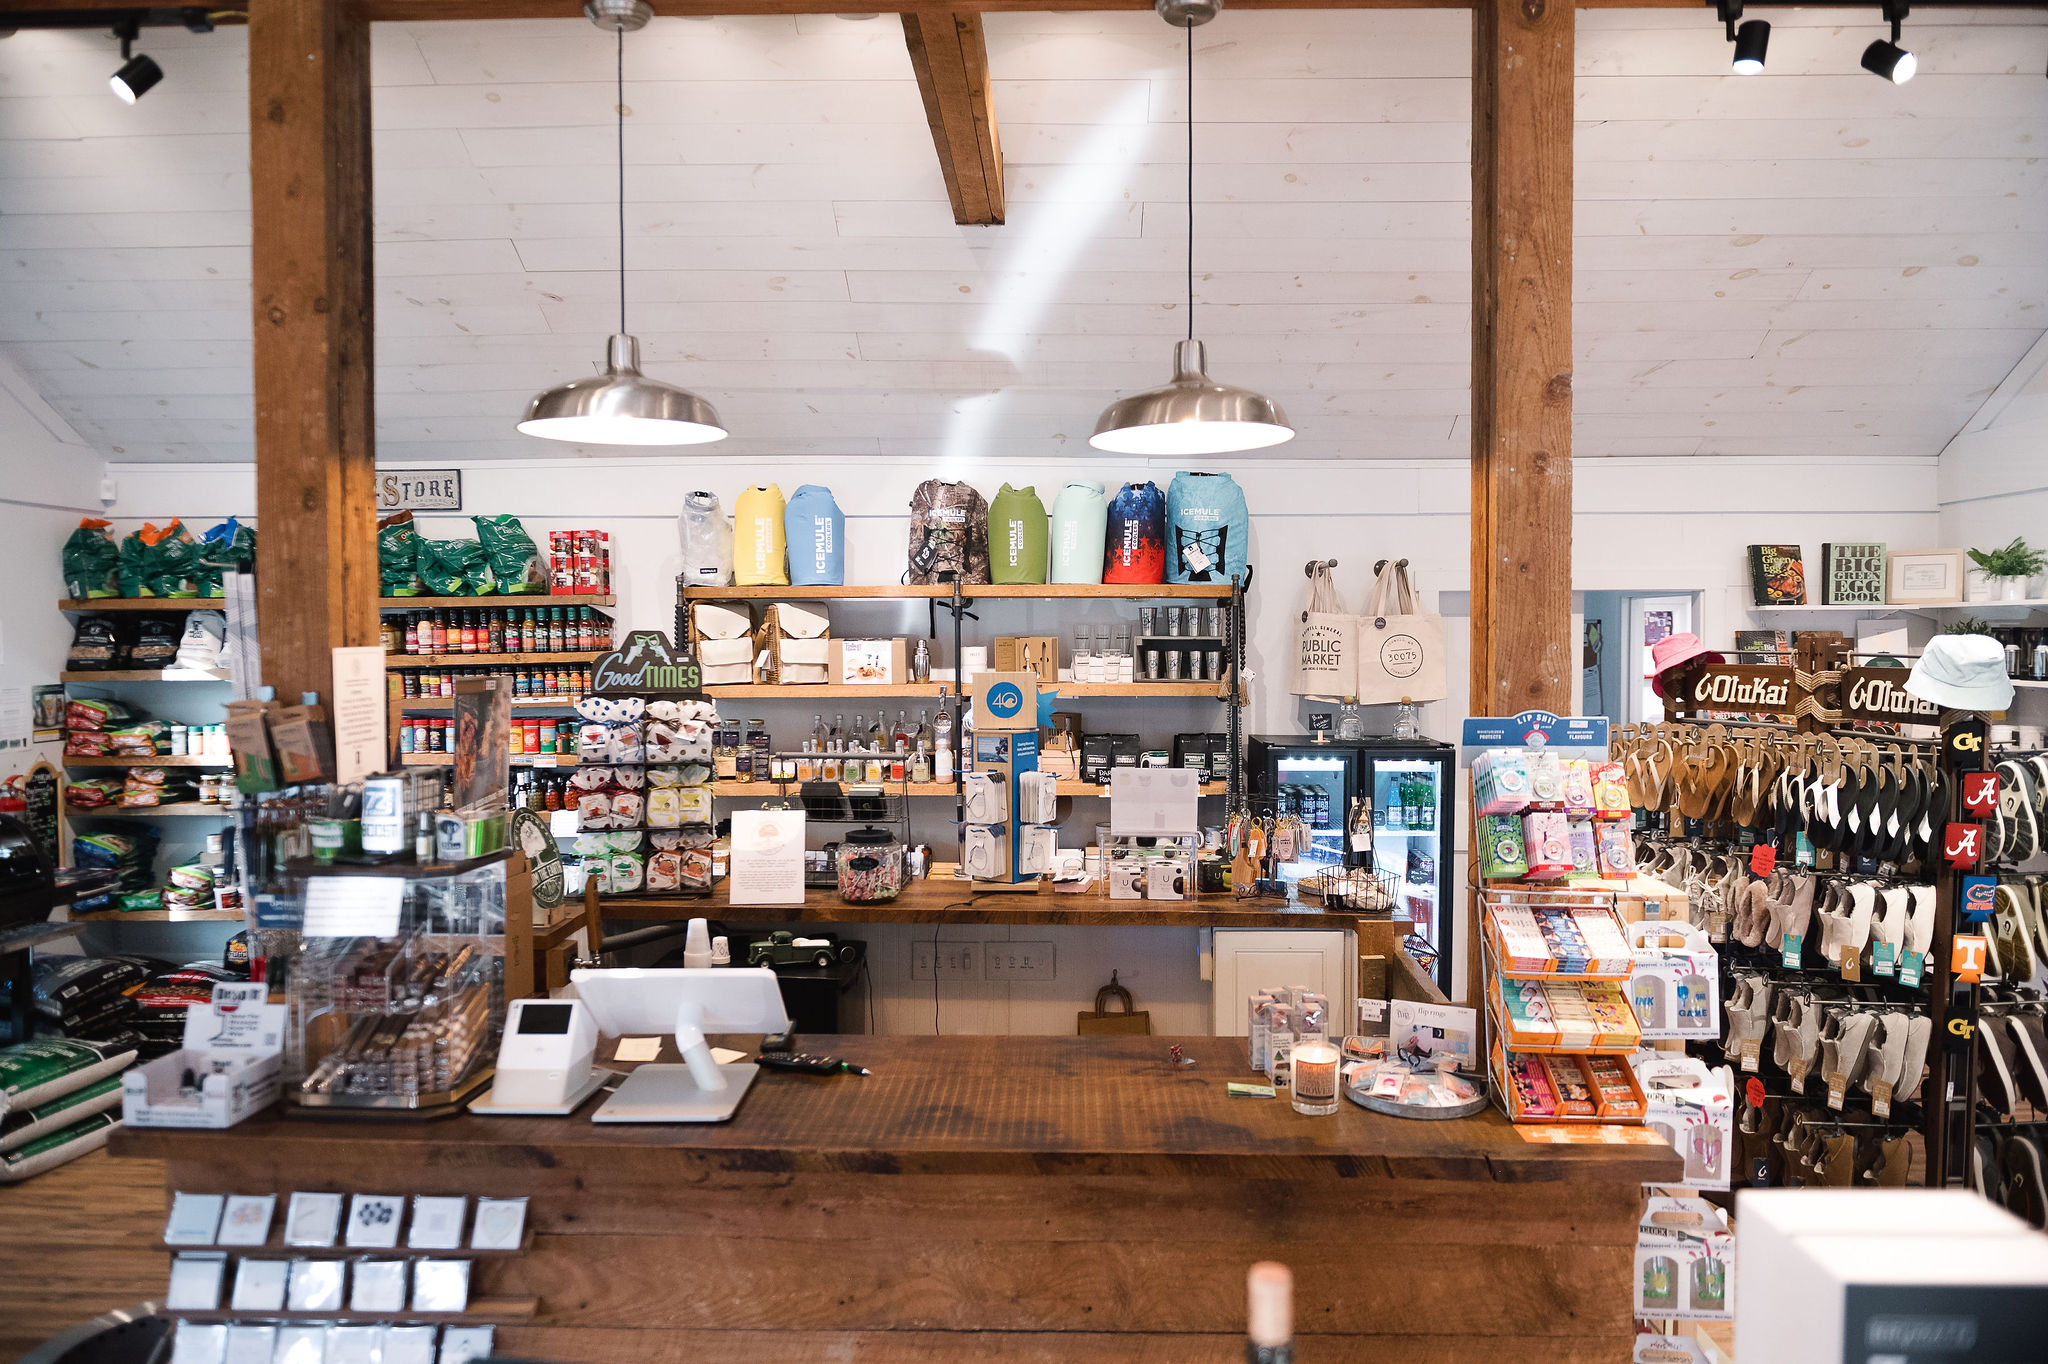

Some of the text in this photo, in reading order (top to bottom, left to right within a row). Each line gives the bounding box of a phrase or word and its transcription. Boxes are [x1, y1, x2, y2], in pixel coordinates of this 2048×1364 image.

[382, 475, 454, 506] STORE
[928, 509, 966, 517] ICEMULE
[1181, 508, 1220, 516] ICEMULE
[755, 516, 766, 574] ICEMULE
[815, 515, 826, 574] ICEMULE
[1009, 519, 1017, 566] ICEMULE
[1122, 519, 1132, 566] ICEMULE
[1761, 546, 1777, 557] Big
[1834, 546, 1881, 557] THE
[1762, 556, 1790, 564] Green
[1835, 558, 1881, 572] BIG
[1763, 564, 1782, 574] Egg
[1834, 572, 1881, 580] GREEN
[1835, 580, 1881, 592] EGG
[1834, 593, 1881, 602] BOOK
[1302, 639, 1341, 652] PUBLIC
[1302, 653, 1341, 665] MARKET
[1388, 652, 1416, 662] 30075
[594, 653, 699, 691] Good TIMES
[1711, 675, 1790, 705] OluKai
[1516, 713, 1557, 726] LIP SHIT
[1953, 733, 1982, 752] GT
[1967, 778, 1996, 806] A
[1946, 829, 1977, 857] A
[1957, 939, 1984, 969] T
[1678, 1009, 1708, 1017] GAME
[1948, 1019, 1974, 1039] GT
